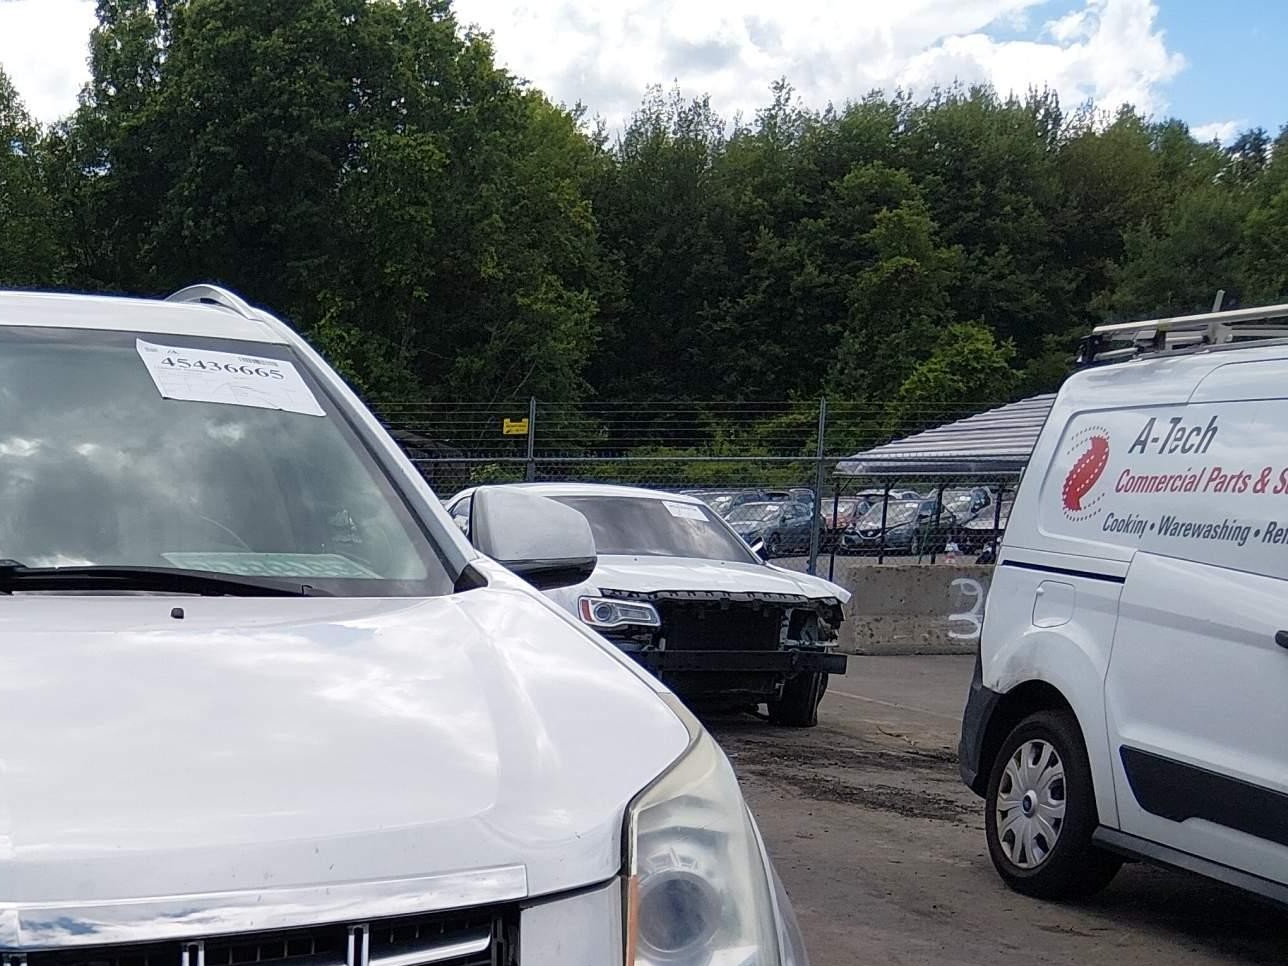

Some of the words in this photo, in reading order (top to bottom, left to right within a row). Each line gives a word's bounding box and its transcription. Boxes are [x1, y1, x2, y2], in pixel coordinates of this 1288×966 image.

[161, 356, 284, 380] 45436665
[1127, 415, 1219, 455] A-Tech
[1115, 466, 1207, 493] Commercial
[1202, 466, 1252, 493] Parts
[1252, 466, 1272, 494] &
[1156, 514, 1252, 547] Warewashing
